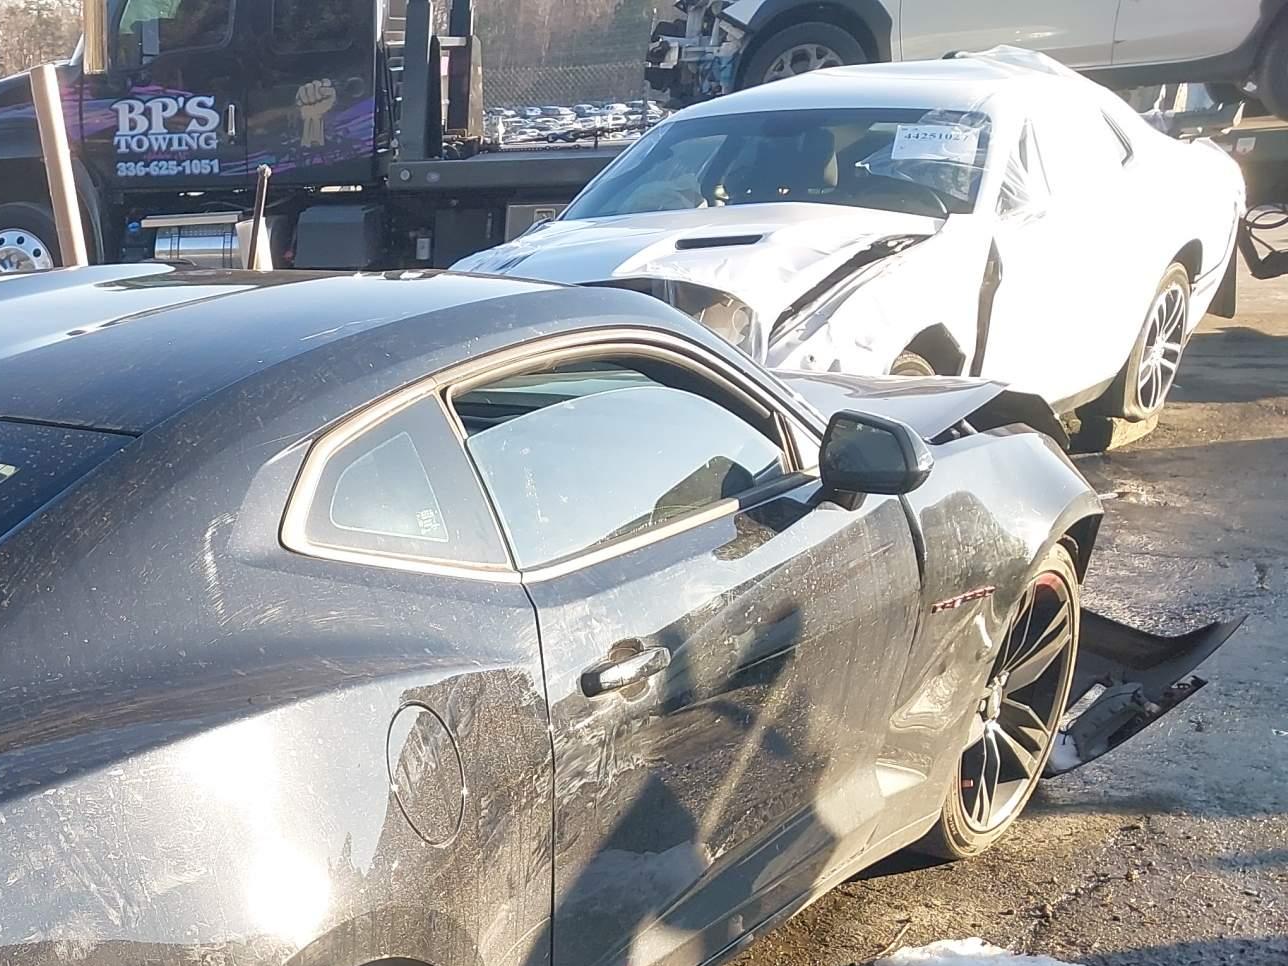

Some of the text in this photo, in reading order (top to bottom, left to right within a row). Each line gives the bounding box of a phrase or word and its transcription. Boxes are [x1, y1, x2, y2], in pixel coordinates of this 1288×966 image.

[111, 96, 220, 136] BP'S
[113, 132, 218, 153] TOWING
[116, 159, 220, 177] 336-625-1051
